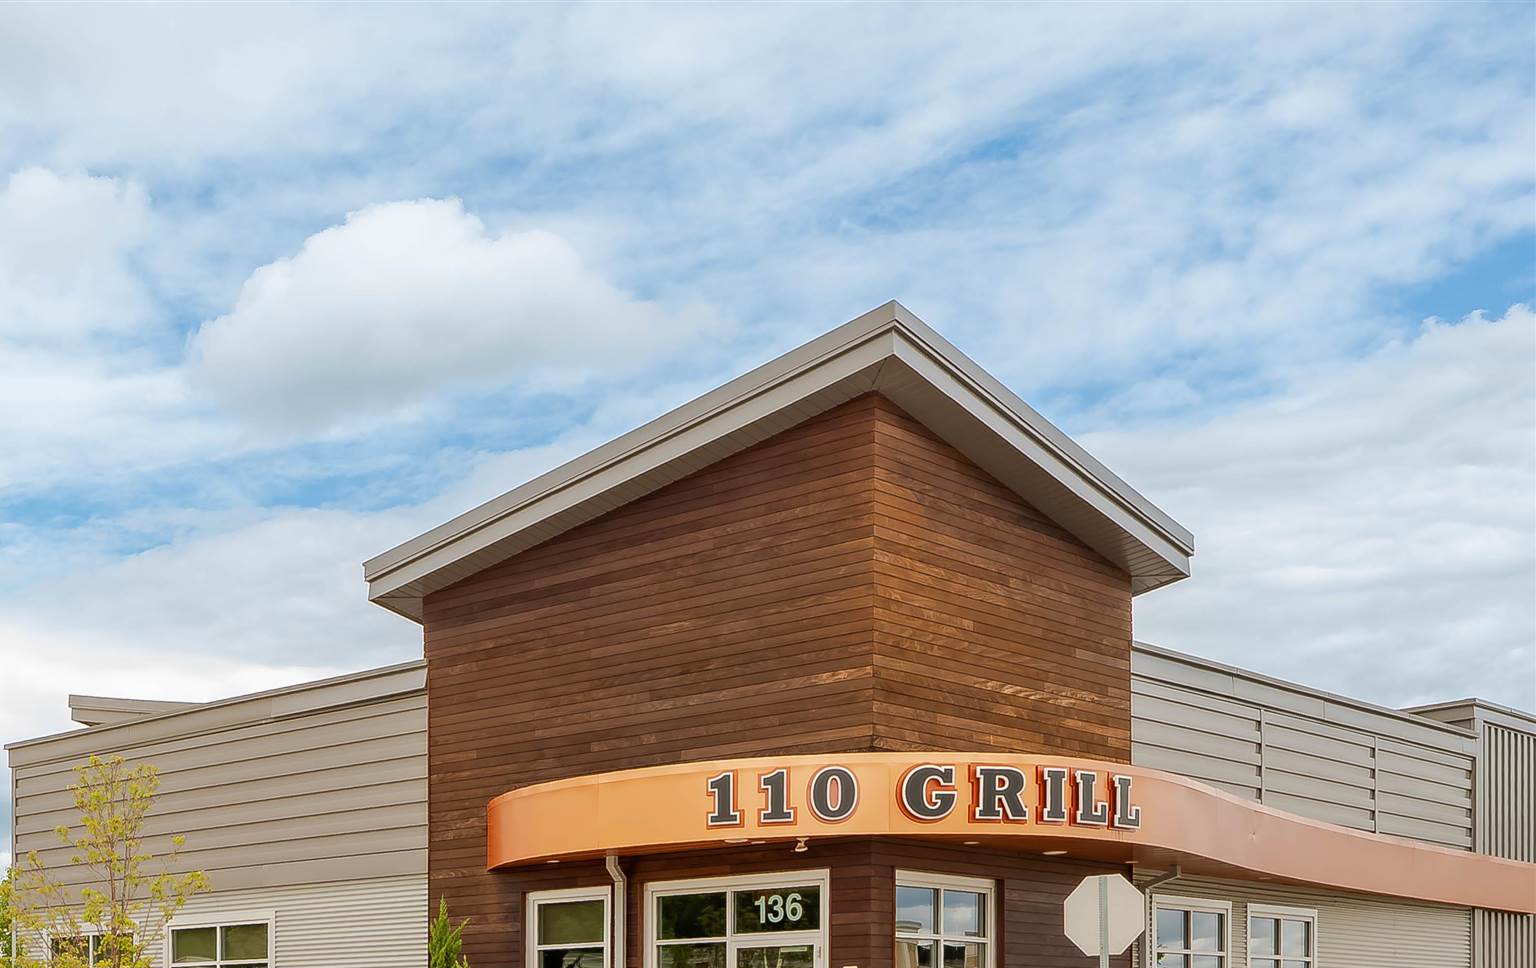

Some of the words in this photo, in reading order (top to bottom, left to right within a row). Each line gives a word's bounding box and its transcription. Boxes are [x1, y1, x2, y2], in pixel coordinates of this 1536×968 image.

[706, 764, 859, 829] 110
[896, 762, 1142, 831] GRILL
[754, 893, 803, 924] 136
